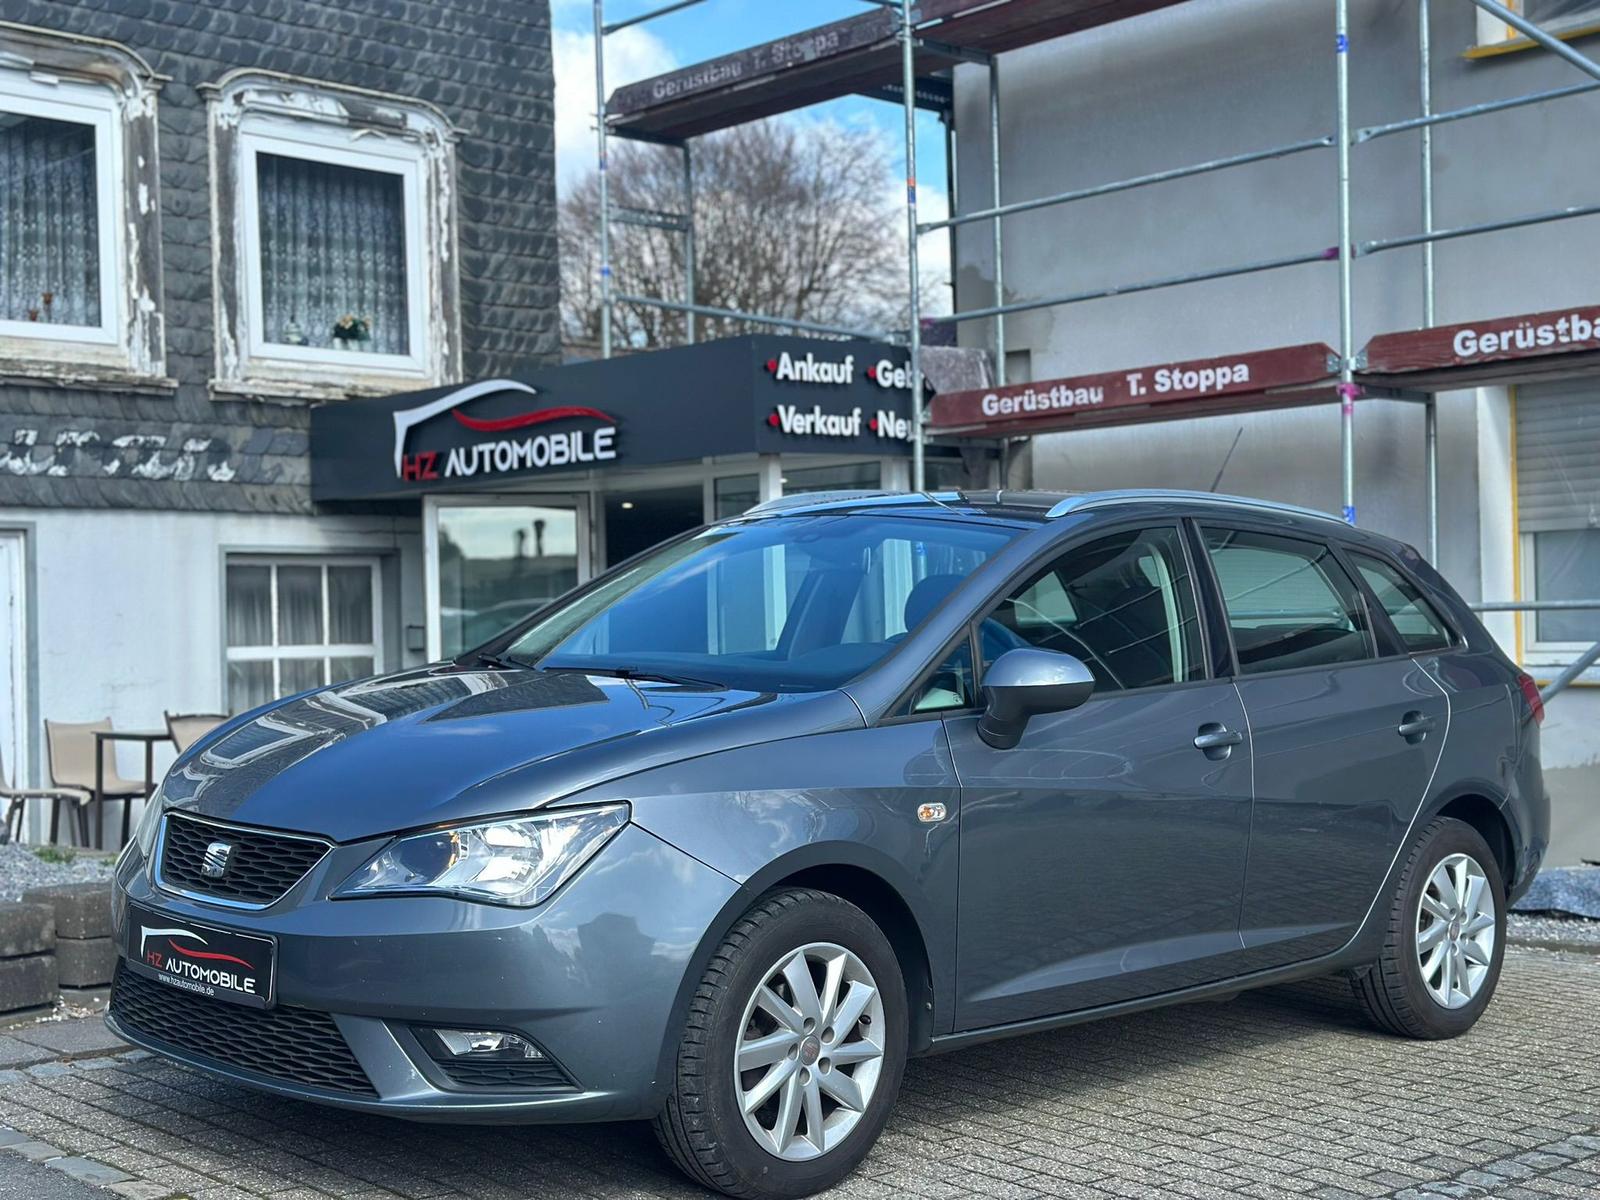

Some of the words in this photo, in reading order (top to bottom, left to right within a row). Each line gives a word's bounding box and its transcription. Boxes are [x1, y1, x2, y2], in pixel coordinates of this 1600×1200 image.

[776, 351, 854, 384] Ankauf
[981, 384, 1104, 417] Gerüstbau
[1126, 372, 1147, 397] T.
[1153, 362, 1250, 393] Stoppa
[777, 404, 862, 437] Verkauf
[402, 450, 439, 481] HZ
[444, 426, 617, 478] AUTOMOBILE
[147, 951, 162, 967] HZ
[165, 957, 256, 994] AUTOMOBILE
[158, 973, 214, 996] www.hzautomobile.de
